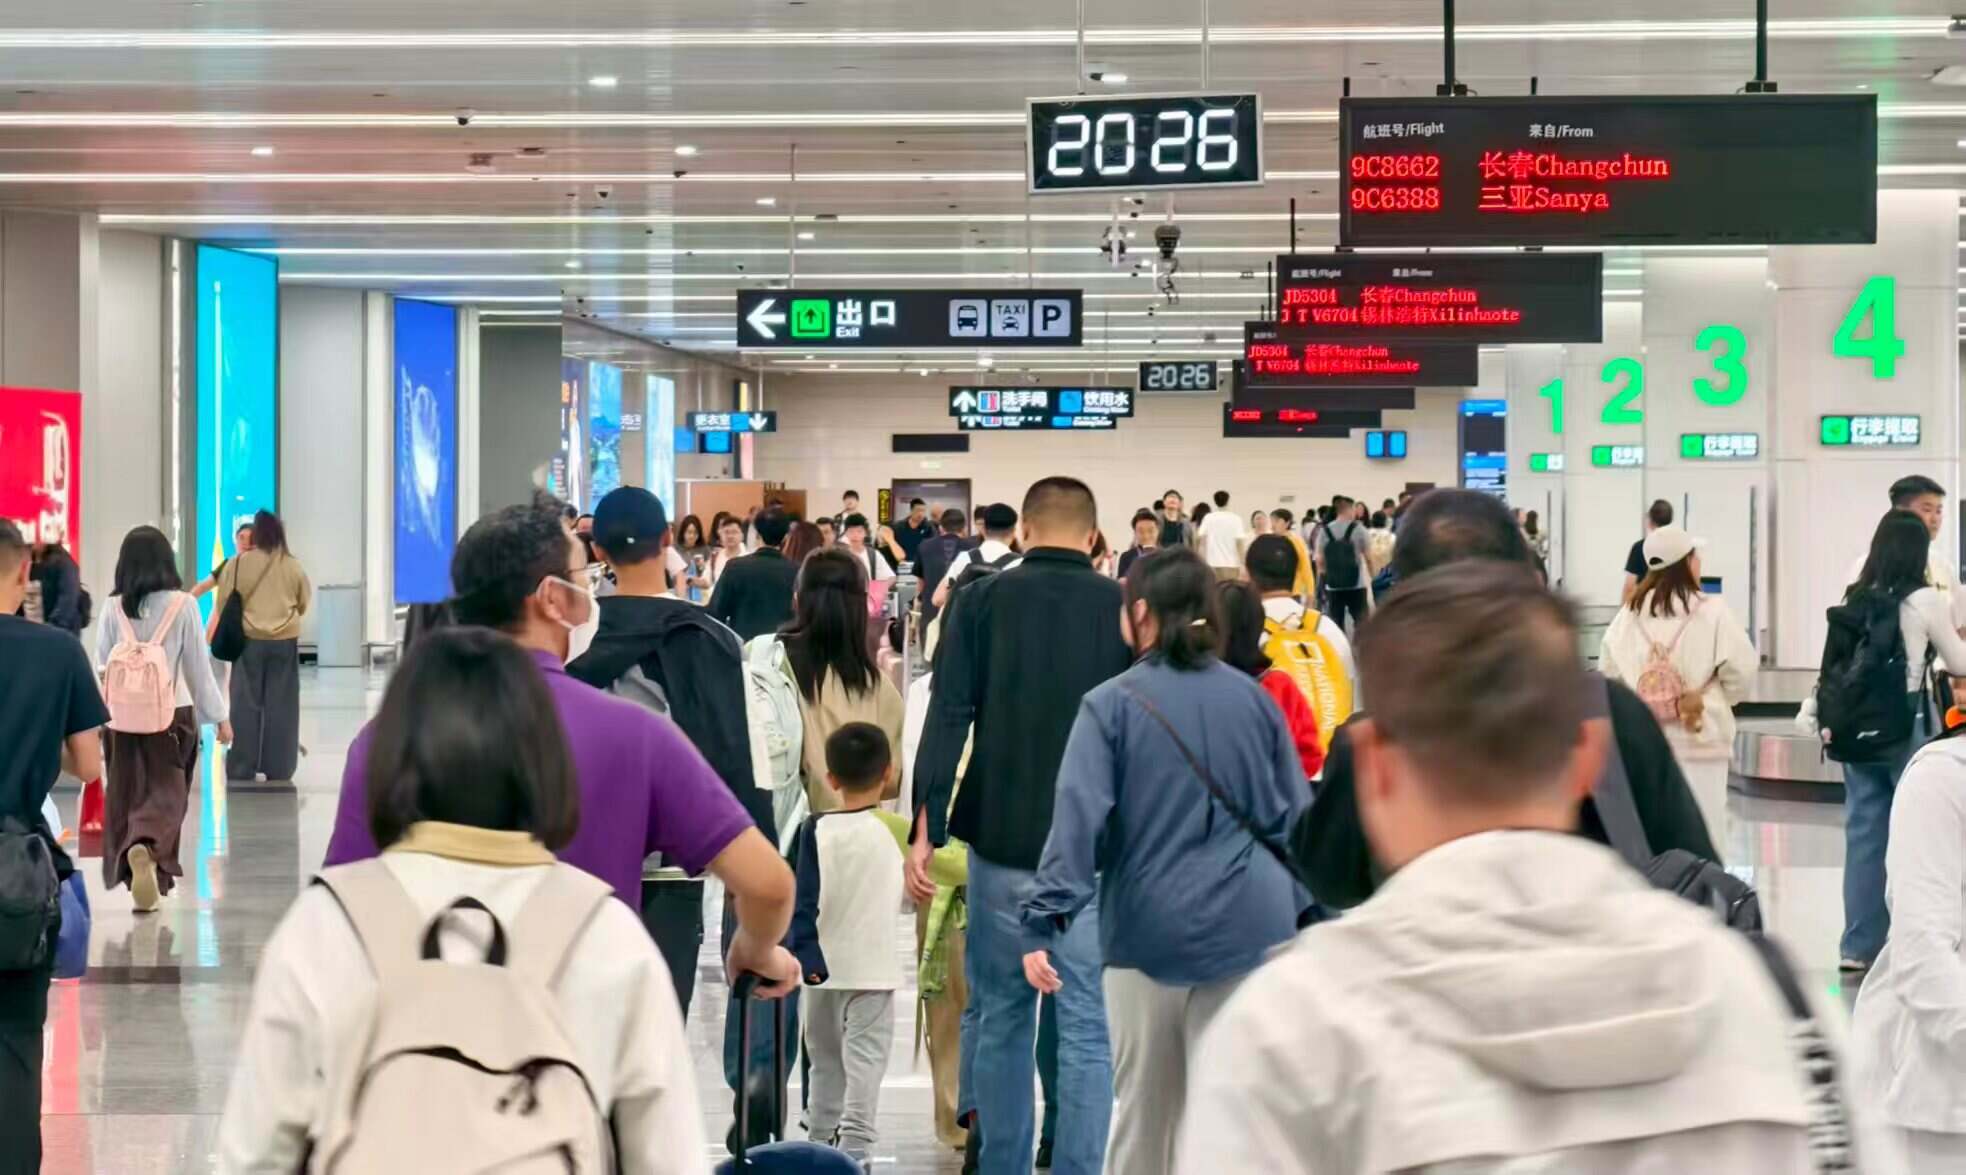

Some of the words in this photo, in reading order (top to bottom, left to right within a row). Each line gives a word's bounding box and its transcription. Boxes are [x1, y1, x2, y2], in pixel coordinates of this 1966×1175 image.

[1363, 122, 1444, 139] 航班号/Flight
[1529, 124, 1594, 138] 来自/From
[1351, 156, 1439, 177] 9C8662
[1351, 187, 1439, 209] 9C6388
[1283, 288, 1338, 305] JD5304
[836, 298, 896, 326] 出口
[995, 304, 1026, 315] TAXI
[1042, 304, 1062, 331] P
[835, 327, 861, 338] Exit
[1833, 275, 1905, 379] 4
[1692, 325, 1748, 406] 3
[1083, 390, 1129, 407] 饮用水
[1600, 357, 1643, 425] 2
[1538, 377, 1564, 434] 1
